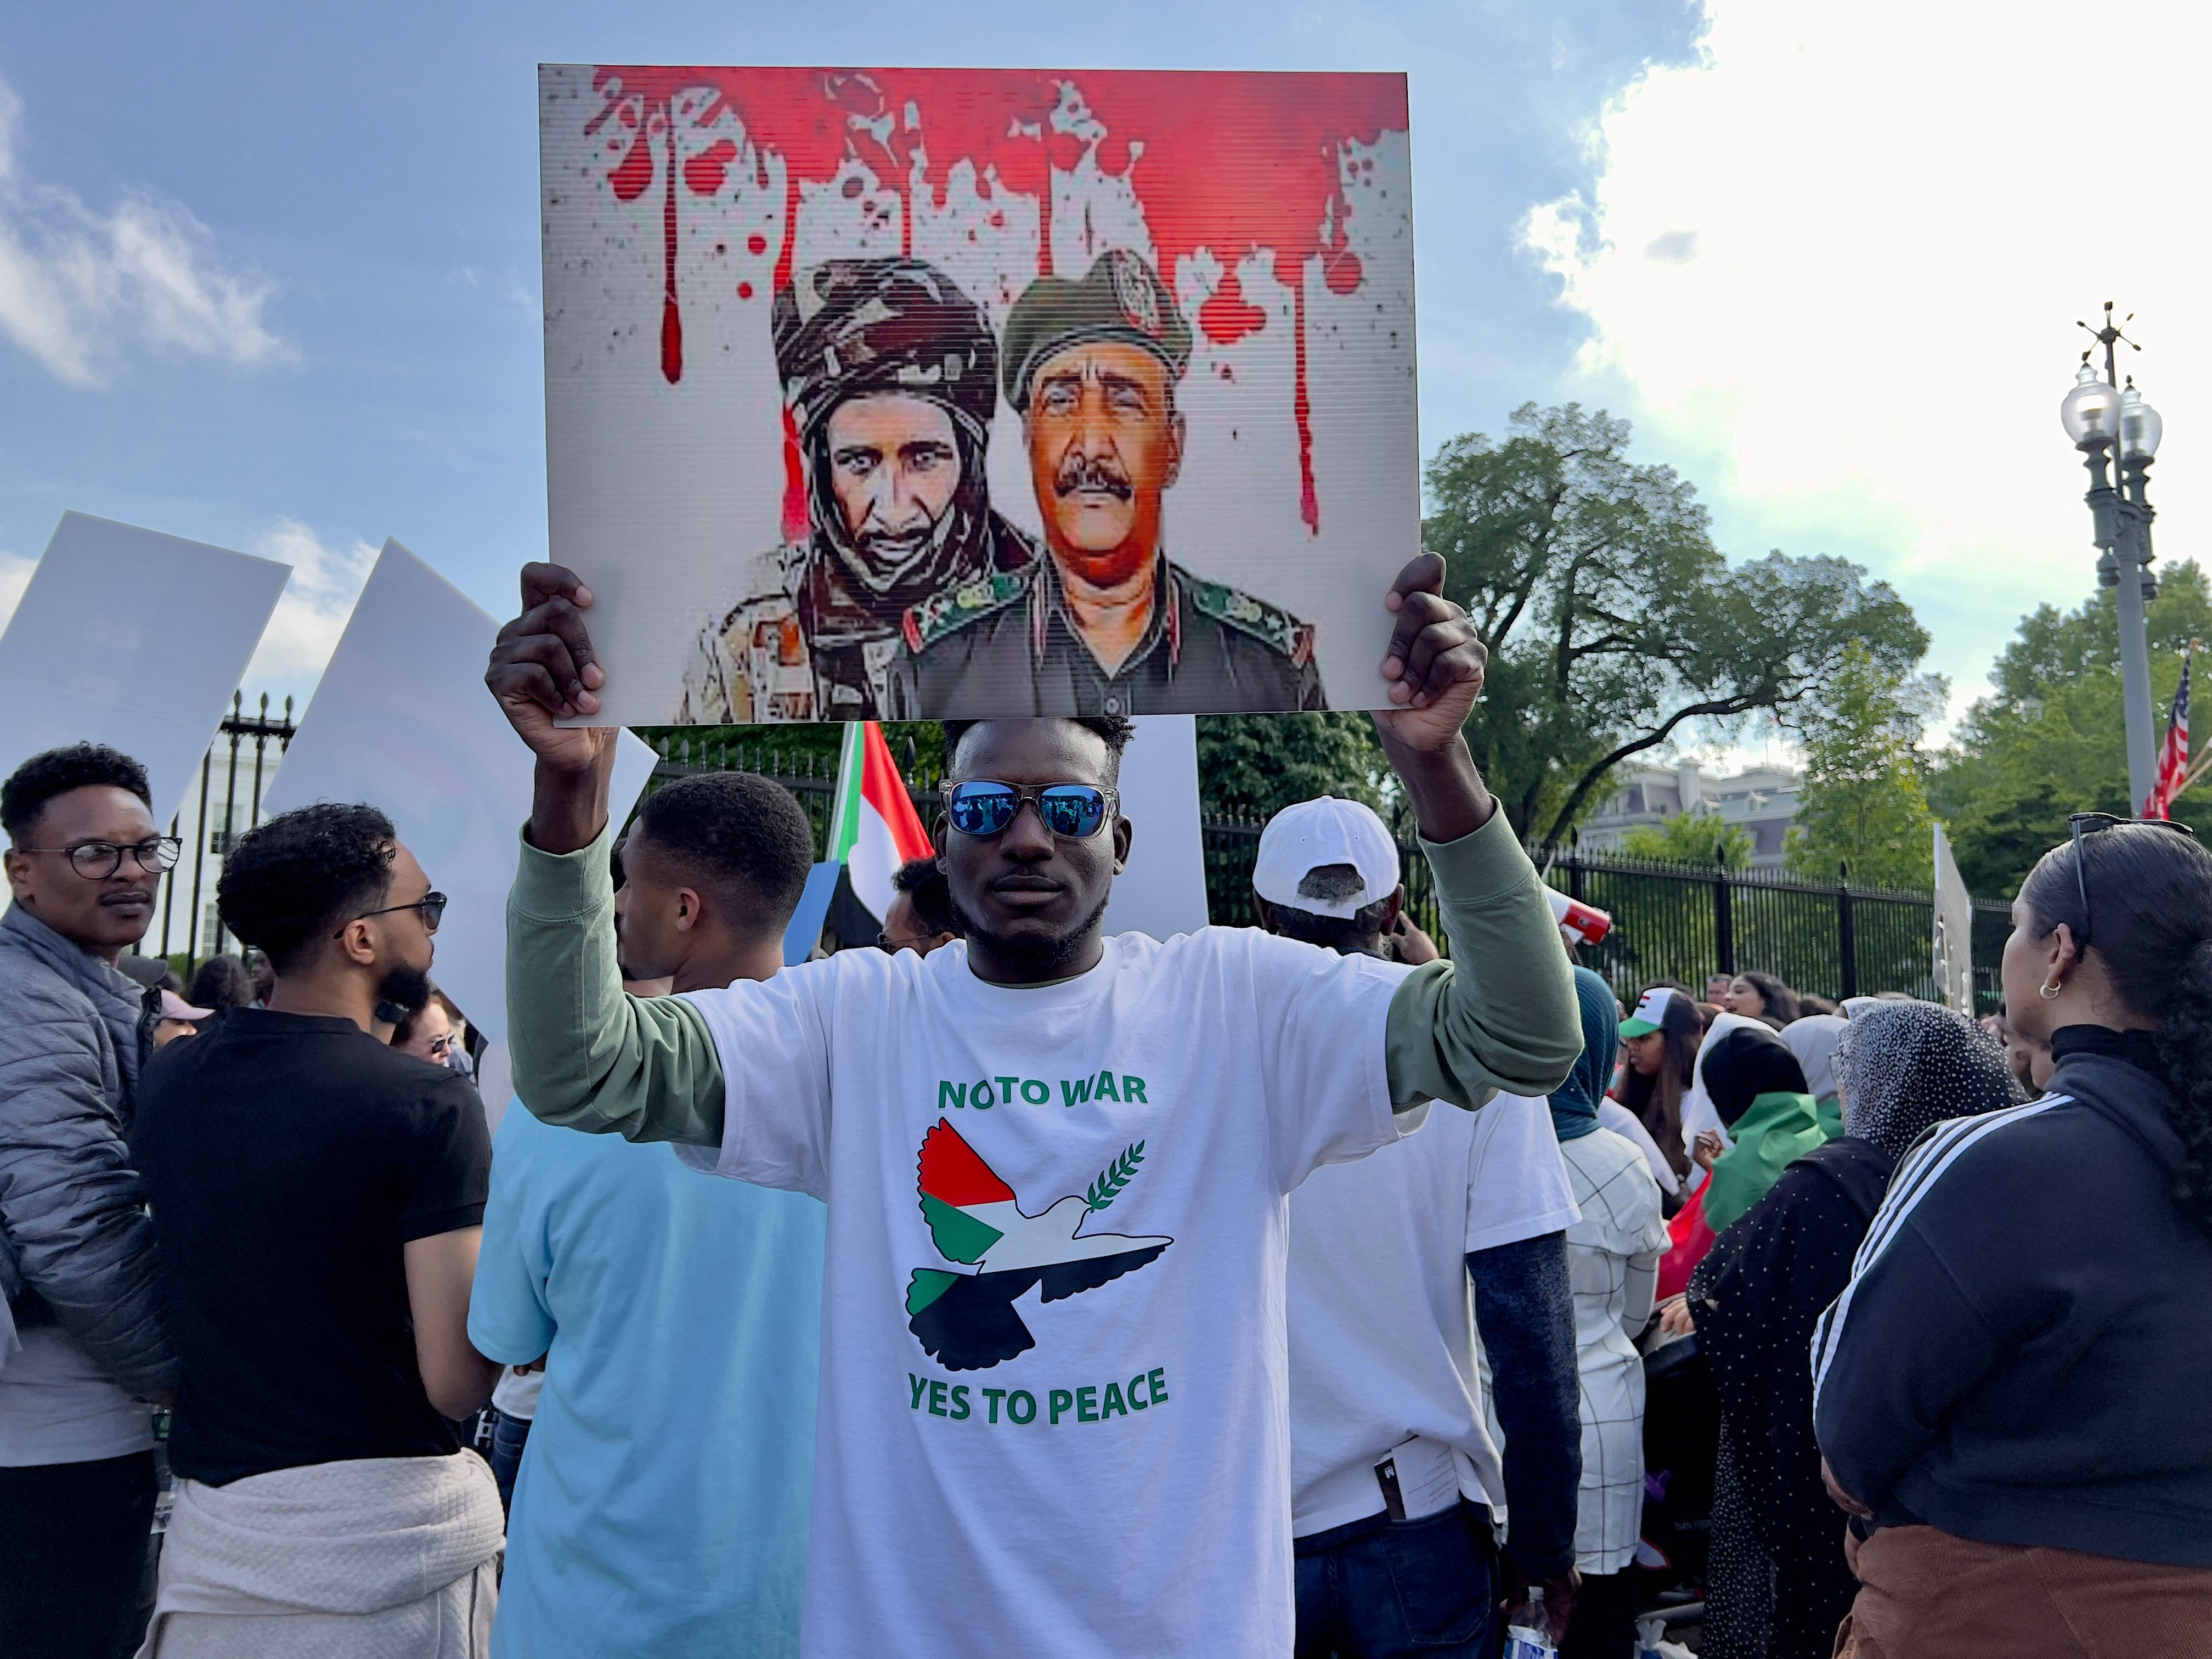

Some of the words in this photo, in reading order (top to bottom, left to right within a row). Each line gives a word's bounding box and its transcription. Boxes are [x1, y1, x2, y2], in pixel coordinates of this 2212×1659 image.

[1060, 1070, 1148, 1107] WAR
[909, 1372, 970, 1420] YES
[982, 1387, 1036, 1425] TO
[1049, 1367, 1169, 1425] PEACE
